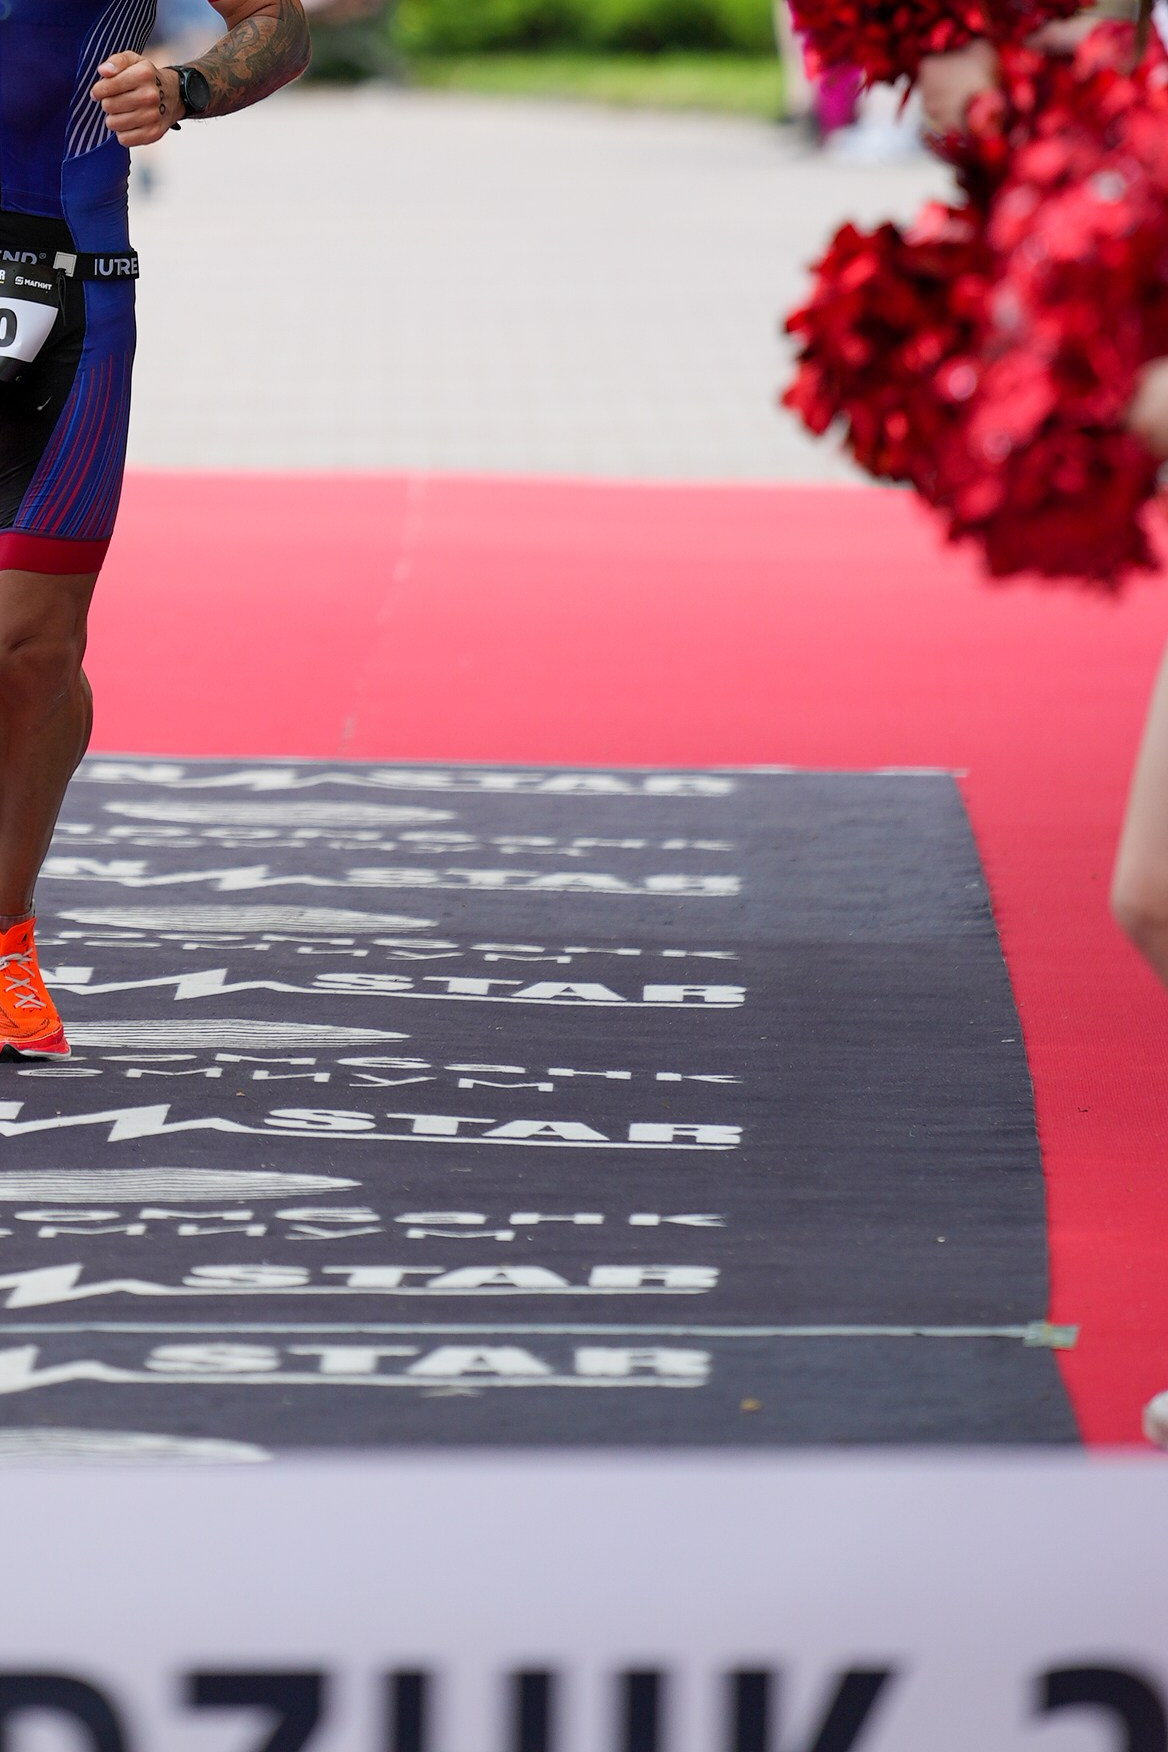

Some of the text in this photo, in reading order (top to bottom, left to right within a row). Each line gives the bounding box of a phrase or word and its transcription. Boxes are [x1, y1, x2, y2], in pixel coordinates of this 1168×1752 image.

[24, 279, 52, 291] МАГНИТ
[367, 767, 734, 793] STAR
[348, 867, 742, 893] STAR
[311, 972, 748, 1003] STAR
[262, 1108, 744, 1145] STAR
[180, 1264, 721, 1289] STAR
[144, 1341, 712, 1376] STAR
